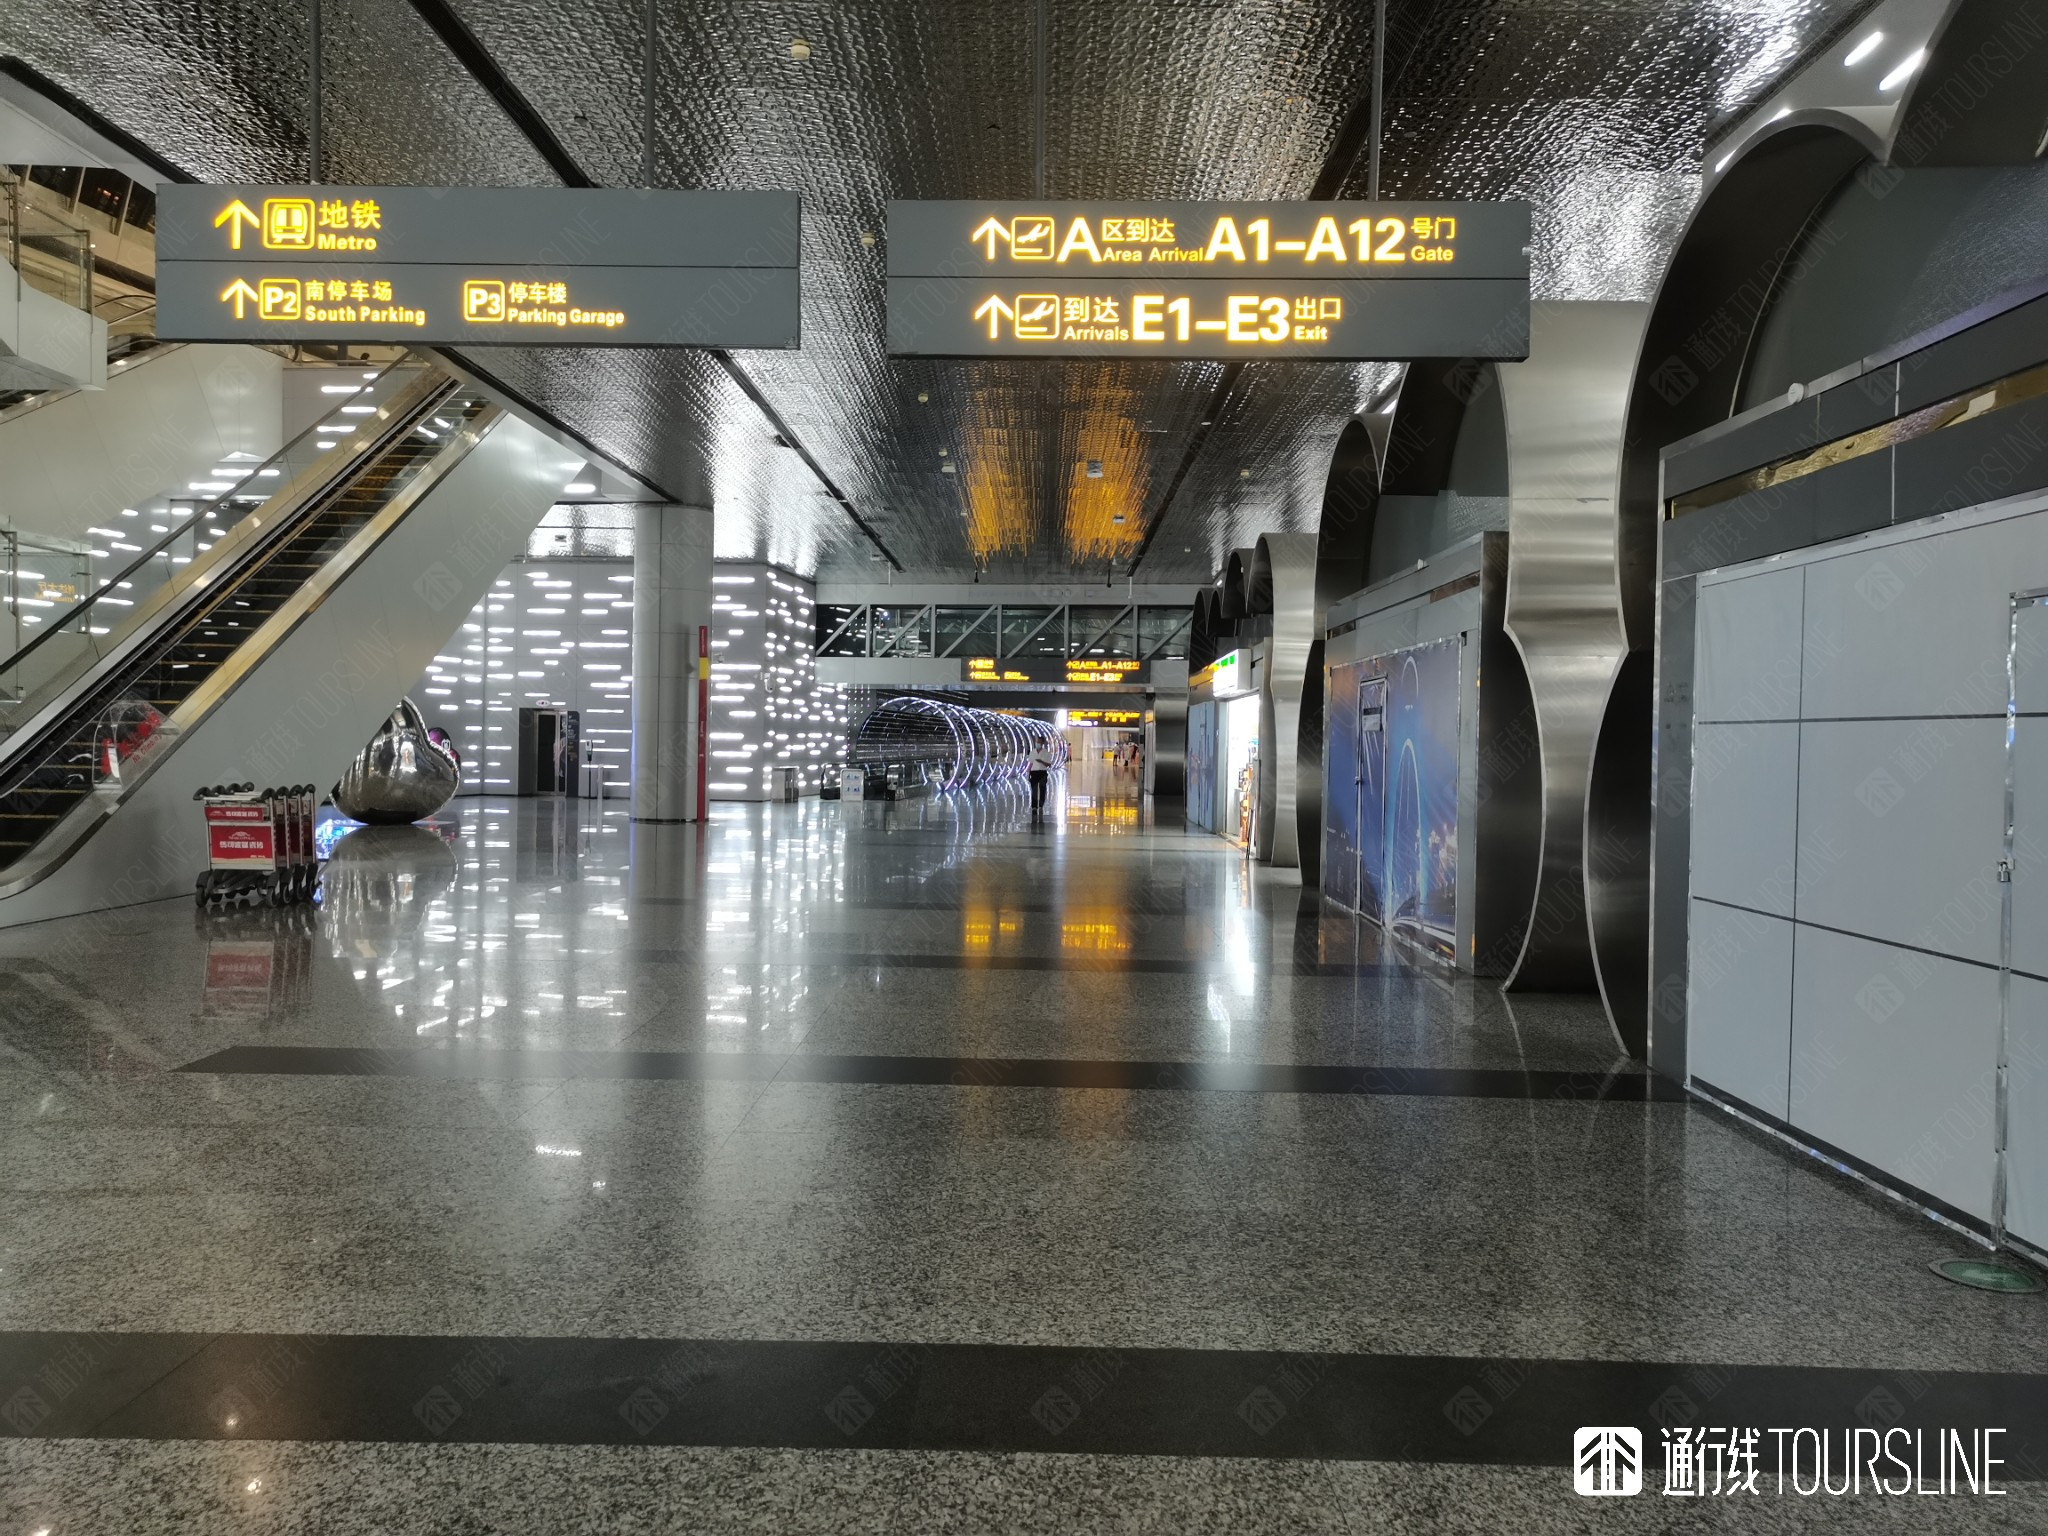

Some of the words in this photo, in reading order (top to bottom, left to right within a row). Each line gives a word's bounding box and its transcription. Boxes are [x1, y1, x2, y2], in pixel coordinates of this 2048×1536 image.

[319, 200, 382, 230] 地铁
[1102, 218, 1176, 243] 区到达
[1410, 217, 1456, 240] 号门
[317, 233, 377, 251] Metro
[1102, 247, 1142, 263] Area
[1149, 246, 1204, 263] Arrival
[1410, 245, 1455, 262] Gate
[264, 285, 298, 314] P2
[305, 280, 393, 302] 南停车场
[469, 286, 501, 315] P3
[508, 282, 567, 305] 停车楼
[305, 305, 357, 322] South
[359, 305, 426, 326] Parking
[507, 307, 567, 328] Parking
[569, 307, 625, 329] Garage
[1063, 296, 1120, 324] 到达
[1294, 296, 1342, 321] 出口
[1064, 325, 1129, 342] Arrivals
[1293, 324, 1329, 342] Exit
